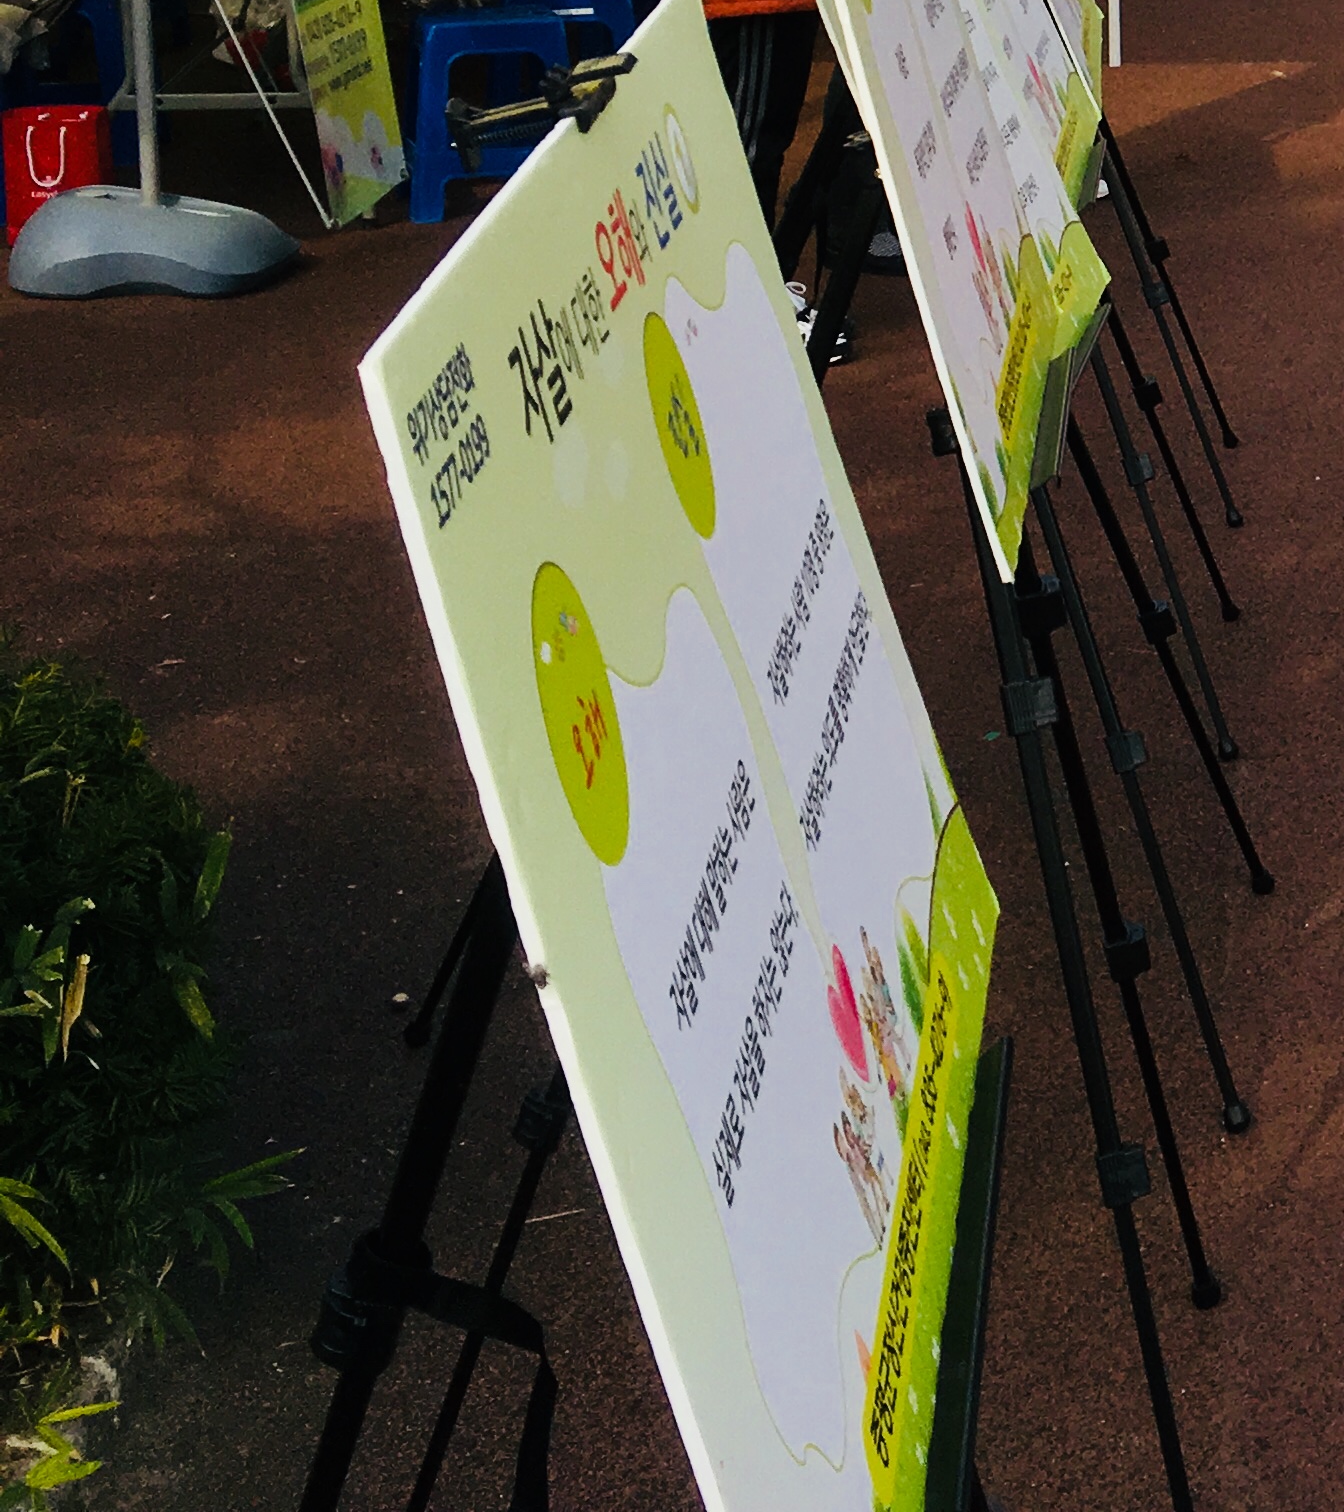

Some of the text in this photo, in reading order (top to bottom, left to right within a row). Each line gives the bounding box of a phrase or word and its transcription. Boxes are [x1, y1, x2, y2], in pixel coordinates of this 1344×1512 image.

[508, 133, 683, 443] 자살에 대한 오해와 진실
[407, 344, 475, 465] 위기상담전화
[431, 414, 491, 529] 1577-0199
[572, 690, 608, 790] 오해
[669, 760, 756, 1030] 자살에 대해 말하는 사람은
[713, 957, 783, 1208] 실제로 자살을 하지는
